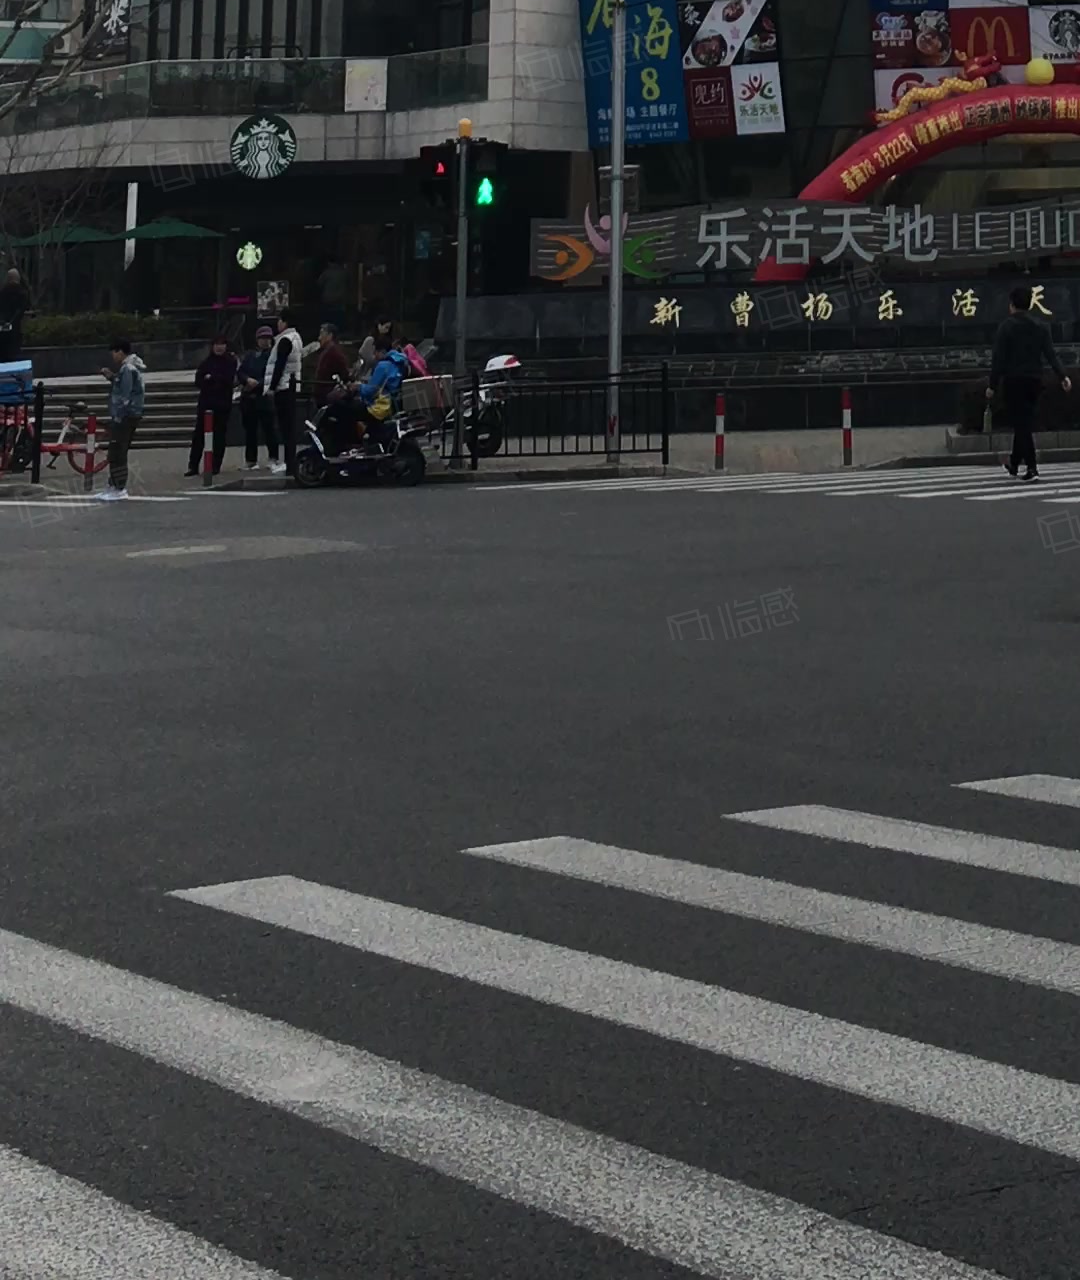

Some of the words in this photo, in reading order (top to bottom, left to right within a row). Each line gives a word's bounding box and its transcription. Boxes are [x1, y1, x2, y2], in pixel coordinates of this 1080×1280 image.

[738, 103, 780, 118] 乐活天地
[696, 203, 939, 270] 乐活天地
[952, 210, 993, 250] LE
